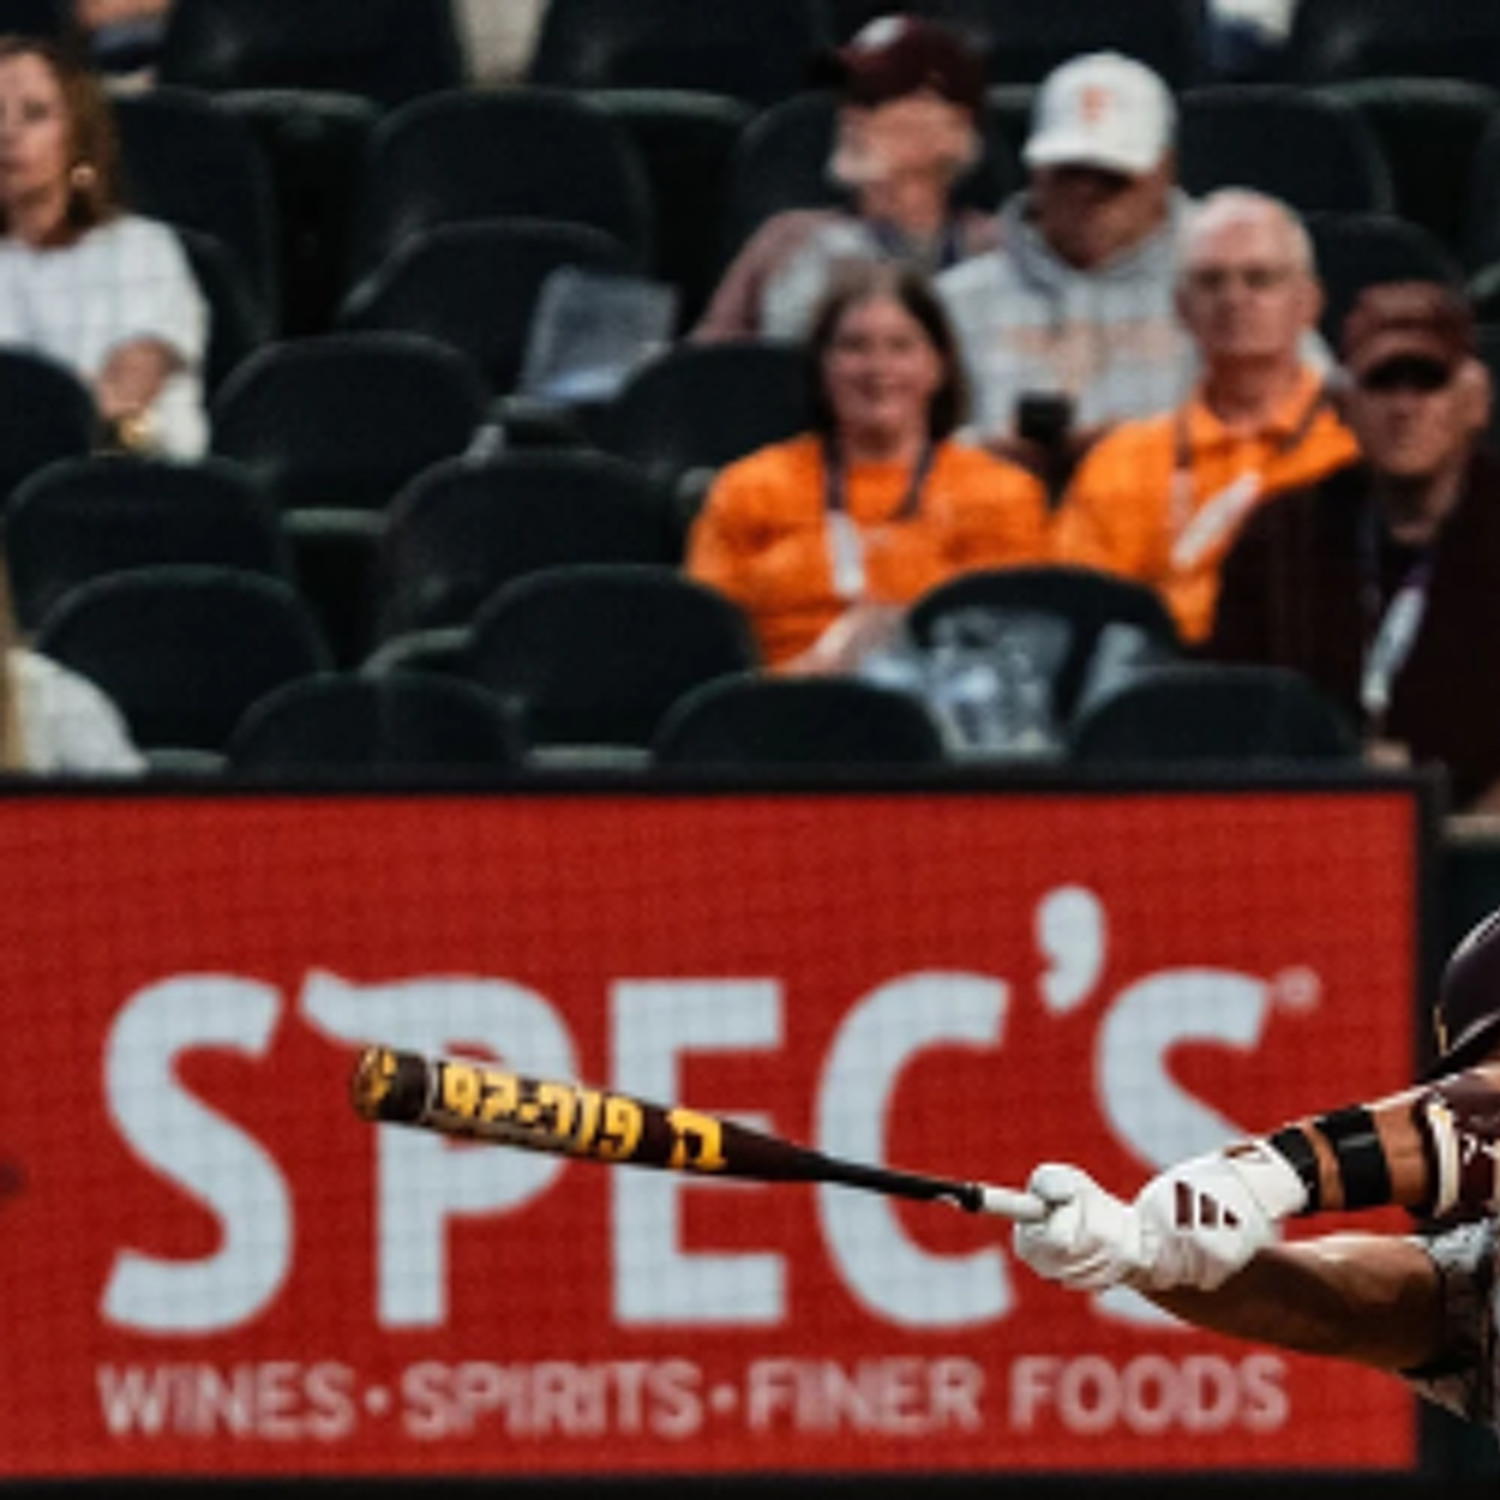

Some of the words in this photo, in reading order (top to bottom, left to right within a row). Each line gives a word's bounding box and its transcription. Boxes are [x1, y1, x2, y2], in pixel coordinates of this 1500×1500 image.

[103, 884, 1266, 1336] SPEC'S
[98, 1361, 358, 1440] WINES
[402, 1359, 705, 1438] SPIRITS
[746, 1355, 986, 1437] FINER
[1010, 1352, 1291, 1435] FOODS
